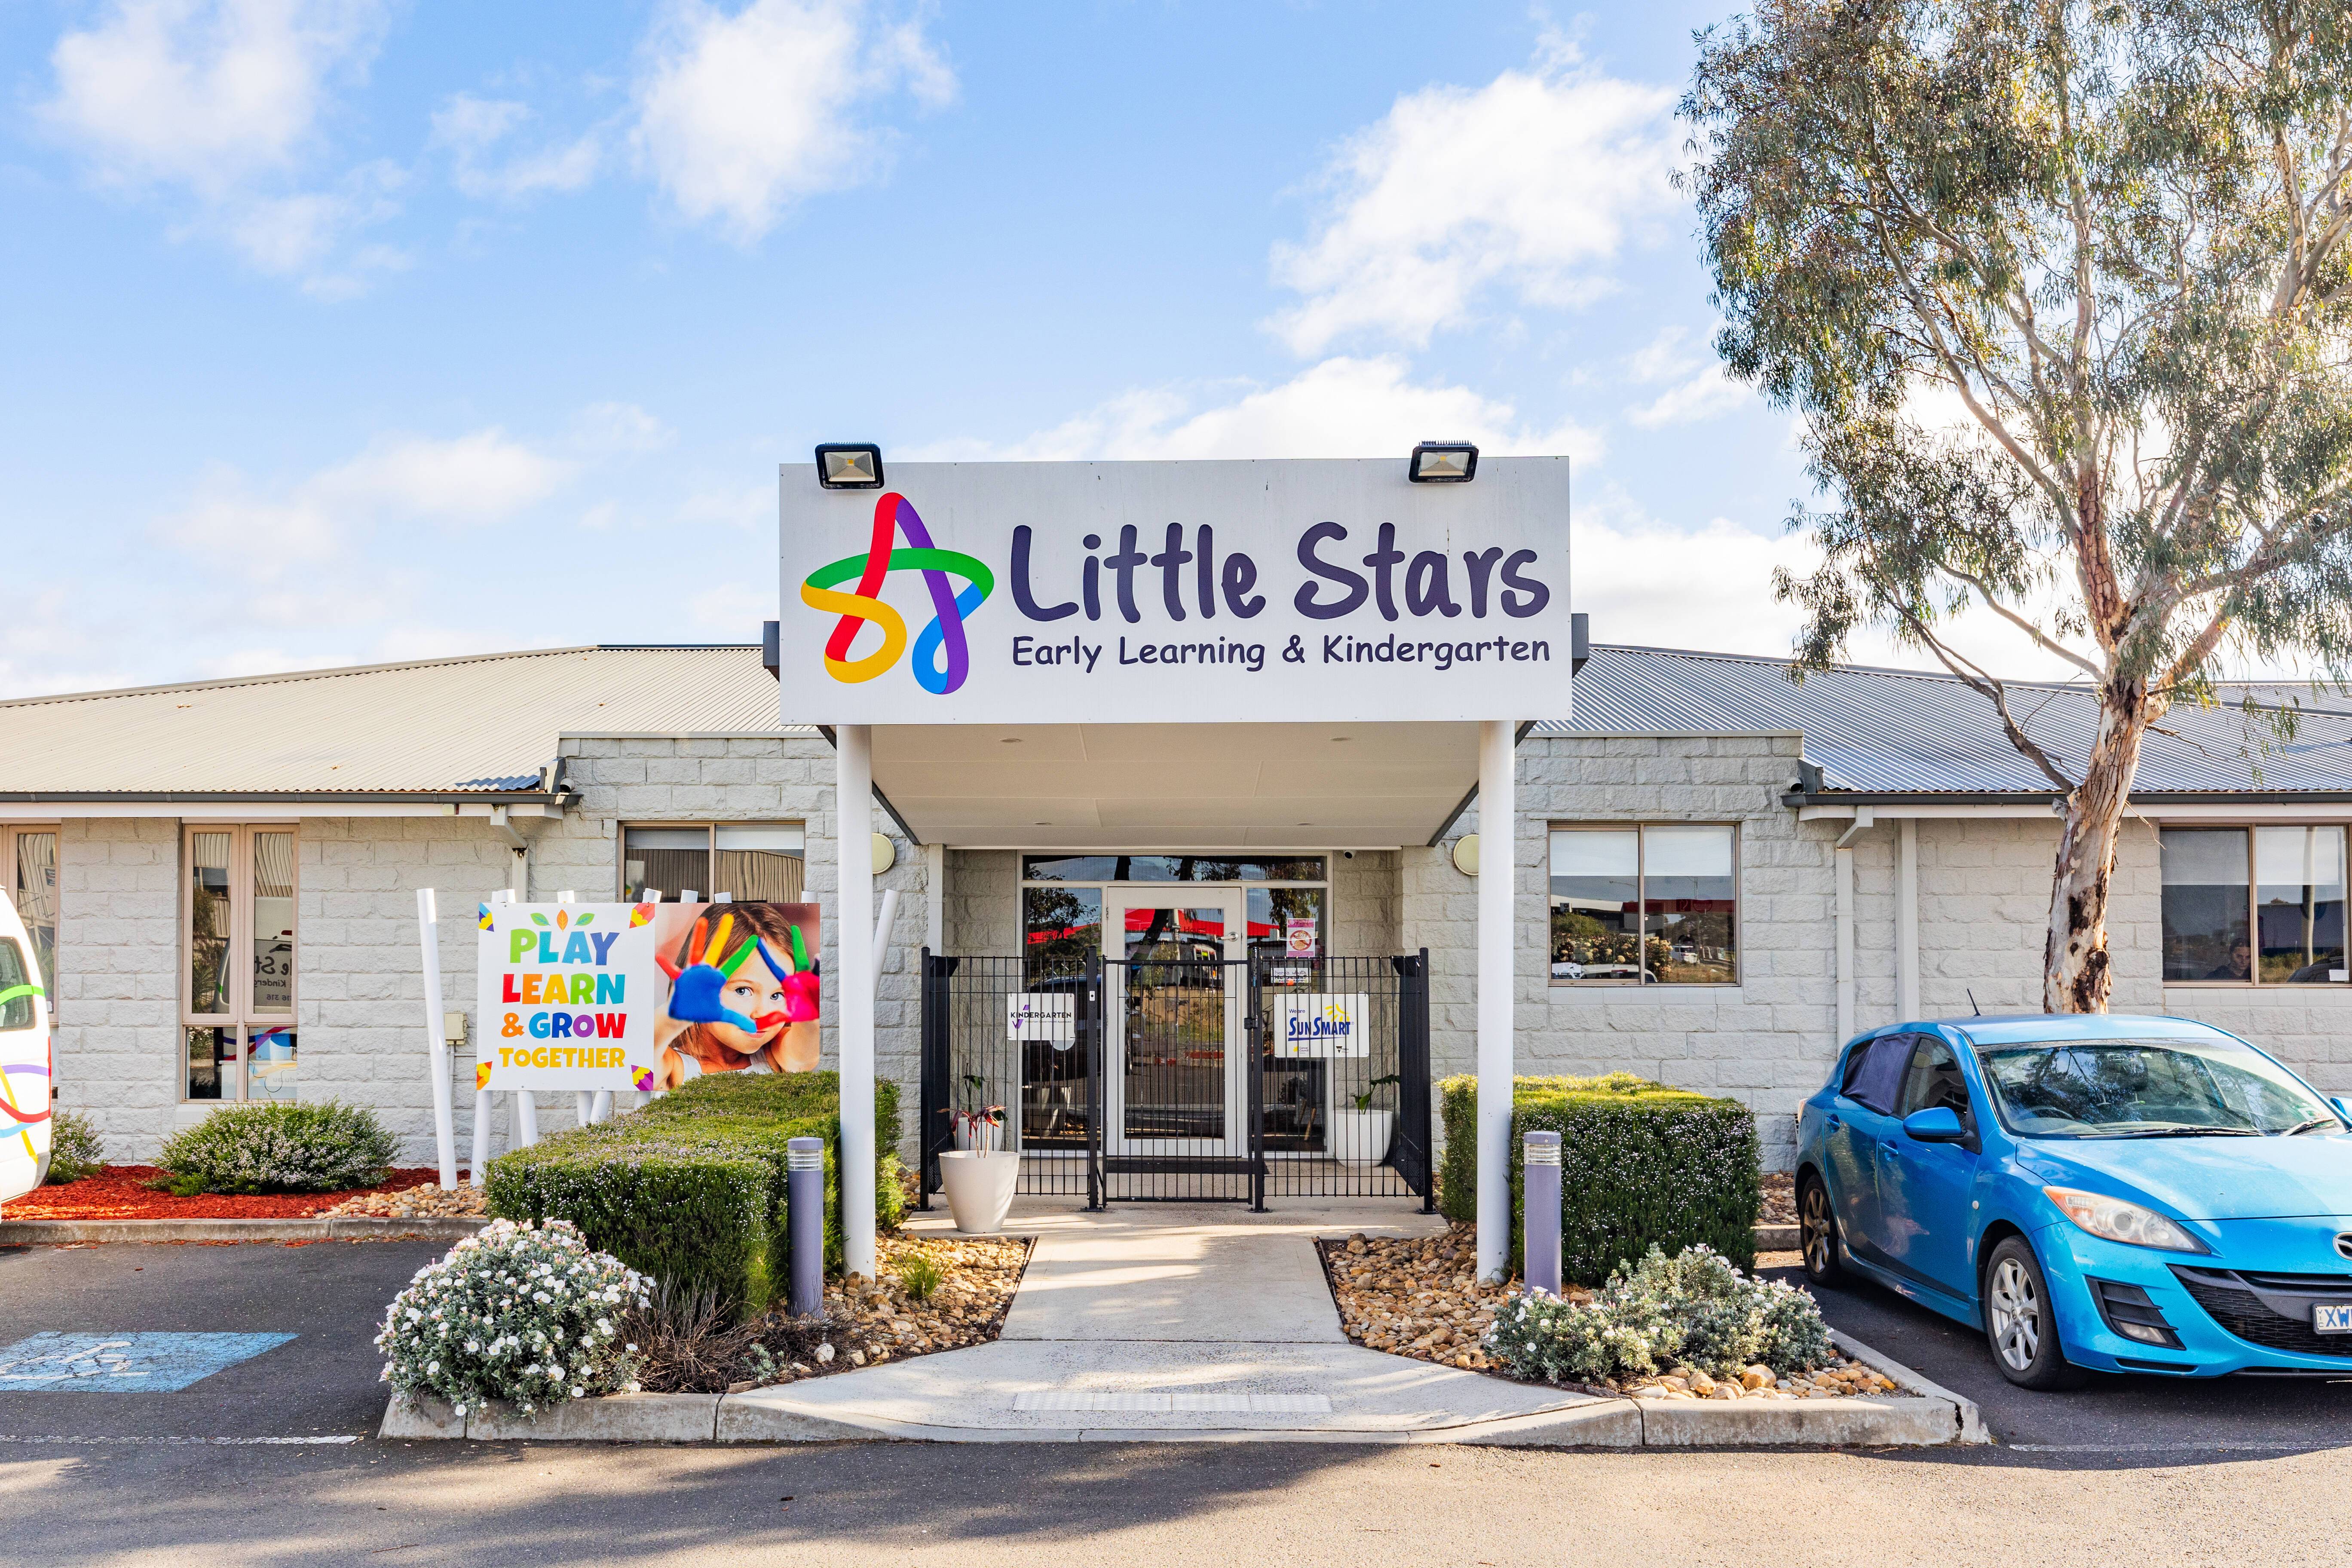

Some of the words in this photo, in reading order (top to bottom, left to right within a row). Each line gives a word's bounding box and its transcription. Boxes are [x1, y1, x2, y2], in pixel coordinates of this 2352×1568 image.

[1010, 522, 1266, 624] Little
[1294, 521, 1550, 622] Stars
[1012, 635, 1102, 674] Early
[1119, 636, 1265, 672] Learning
[1282, 634, 1306, 664] &
[1323, 633, 1550, 671] Kindergarten
[510, 929, 619, 965] PLAY
[502, 974, 625, 1004] LEARN
[501, 1012, 524, 1038] &
[528, 1011, 627, 1039] GROW
[498, 1047, 626, 1069] TOGETHER
[2324, 1308, 2352, 1327] XW
